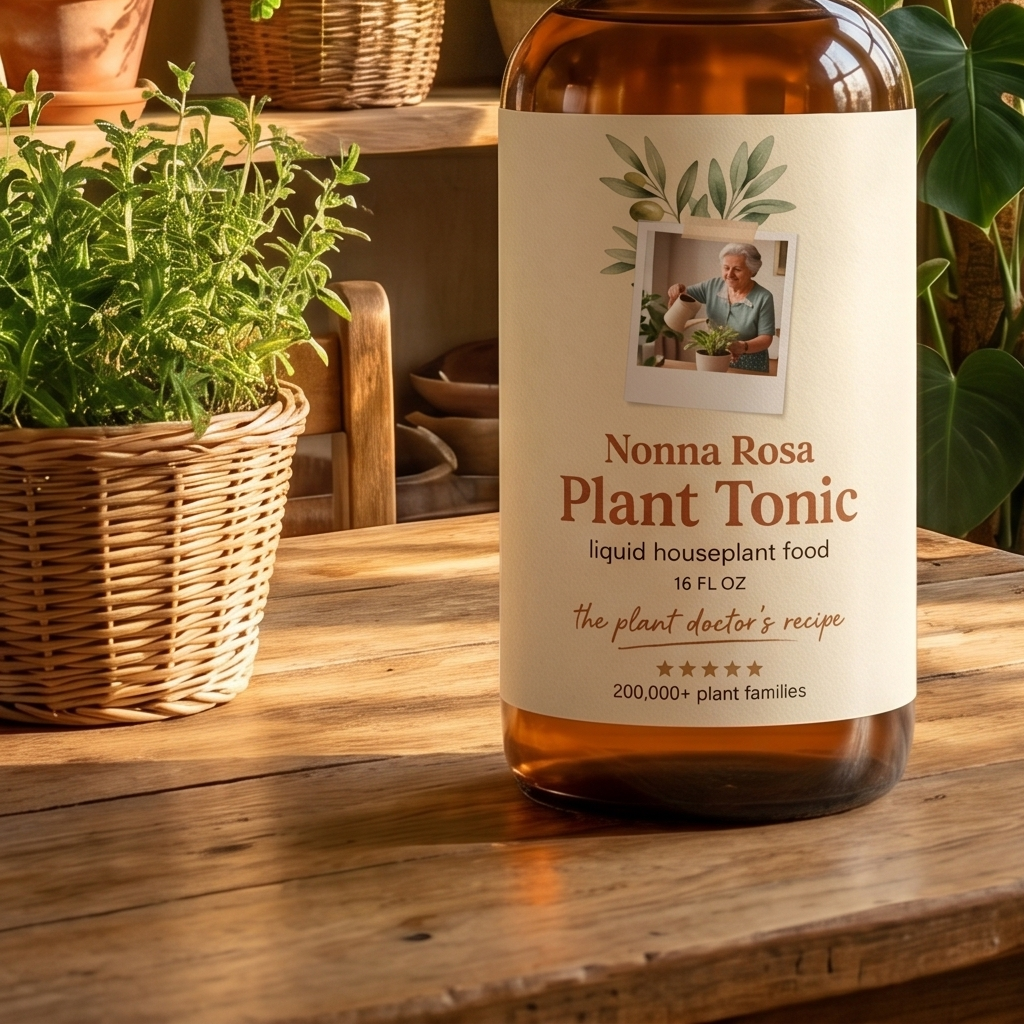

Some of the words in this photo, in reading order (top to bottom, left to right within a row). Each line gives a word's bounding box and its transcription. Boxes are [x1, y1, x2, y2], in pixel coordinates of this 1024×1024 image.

[605, 434, 721, 465] Nonna
[732, 436, 815, 465] Rosa
[560, 475, 699, 527] Plant
[715, 476, 857, 526] Tonic
[590, 539, 645, 564] liquid
[655, 542, 776, 566] houseplant
[783, 539, 828, 560] food
[674, 577, 691, 590] 16
[698, 577, 717, 590] FL
[721, 577, 746, 590] OZ
[573, 602, 608, 629] the
[611, 606, 683, 642] plant
[687, 605, 775, 636] doctor's
[784, 613, 845, 642] recipe
[614, 684, 690, 701] 200,000+
[697, 686, 739, 705] plant
[744, 684, 806, 700] families
